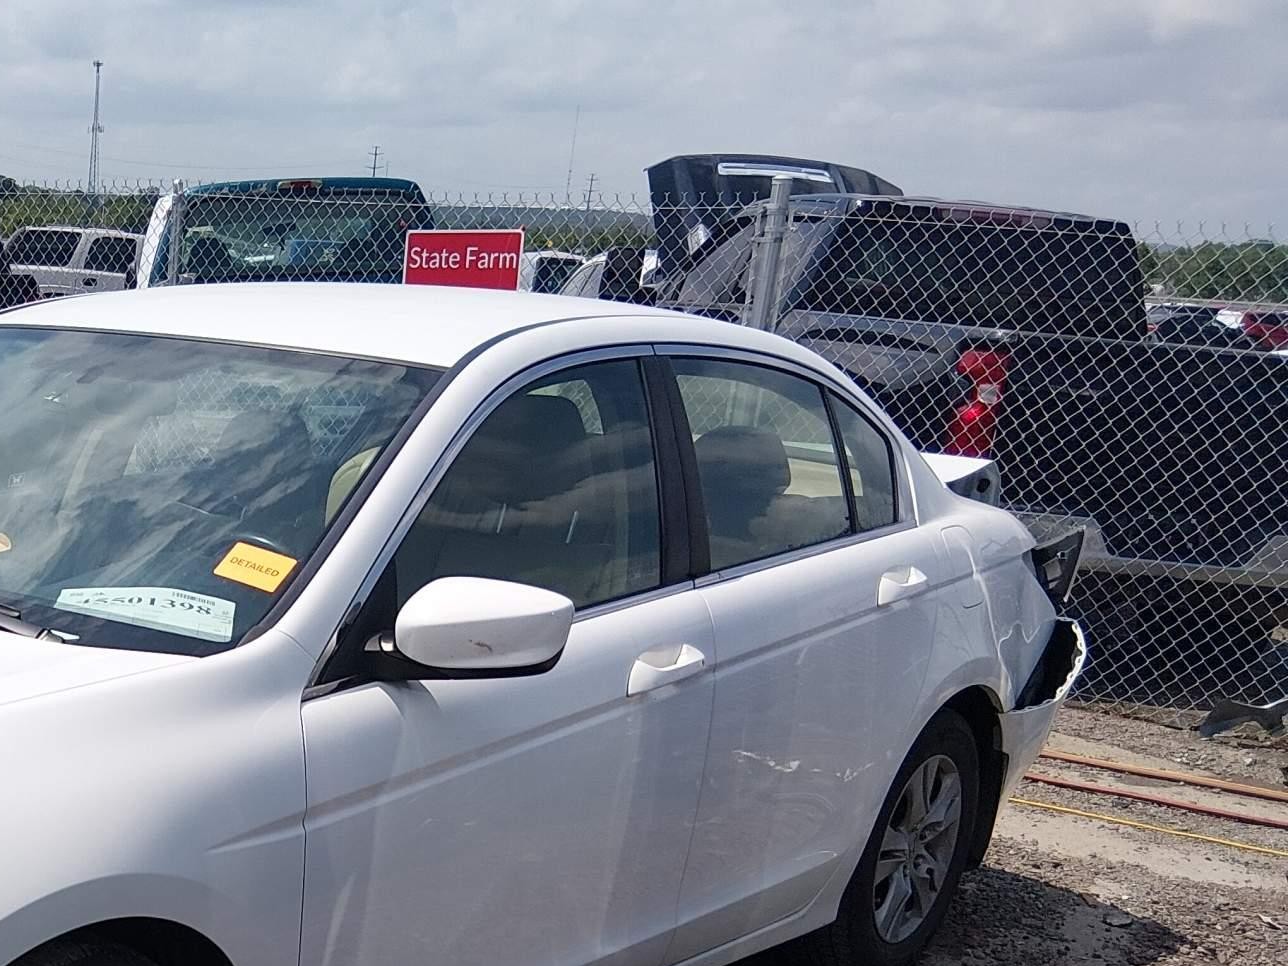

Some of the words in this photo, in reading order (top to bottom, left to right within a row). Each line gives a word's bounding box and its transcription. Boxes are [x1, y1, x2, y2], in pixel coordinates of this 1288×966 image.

[409, 246, 460, 269] State
[465, 246, 517, 269] Farm
[230, 556, 280, 577] DETAILED
